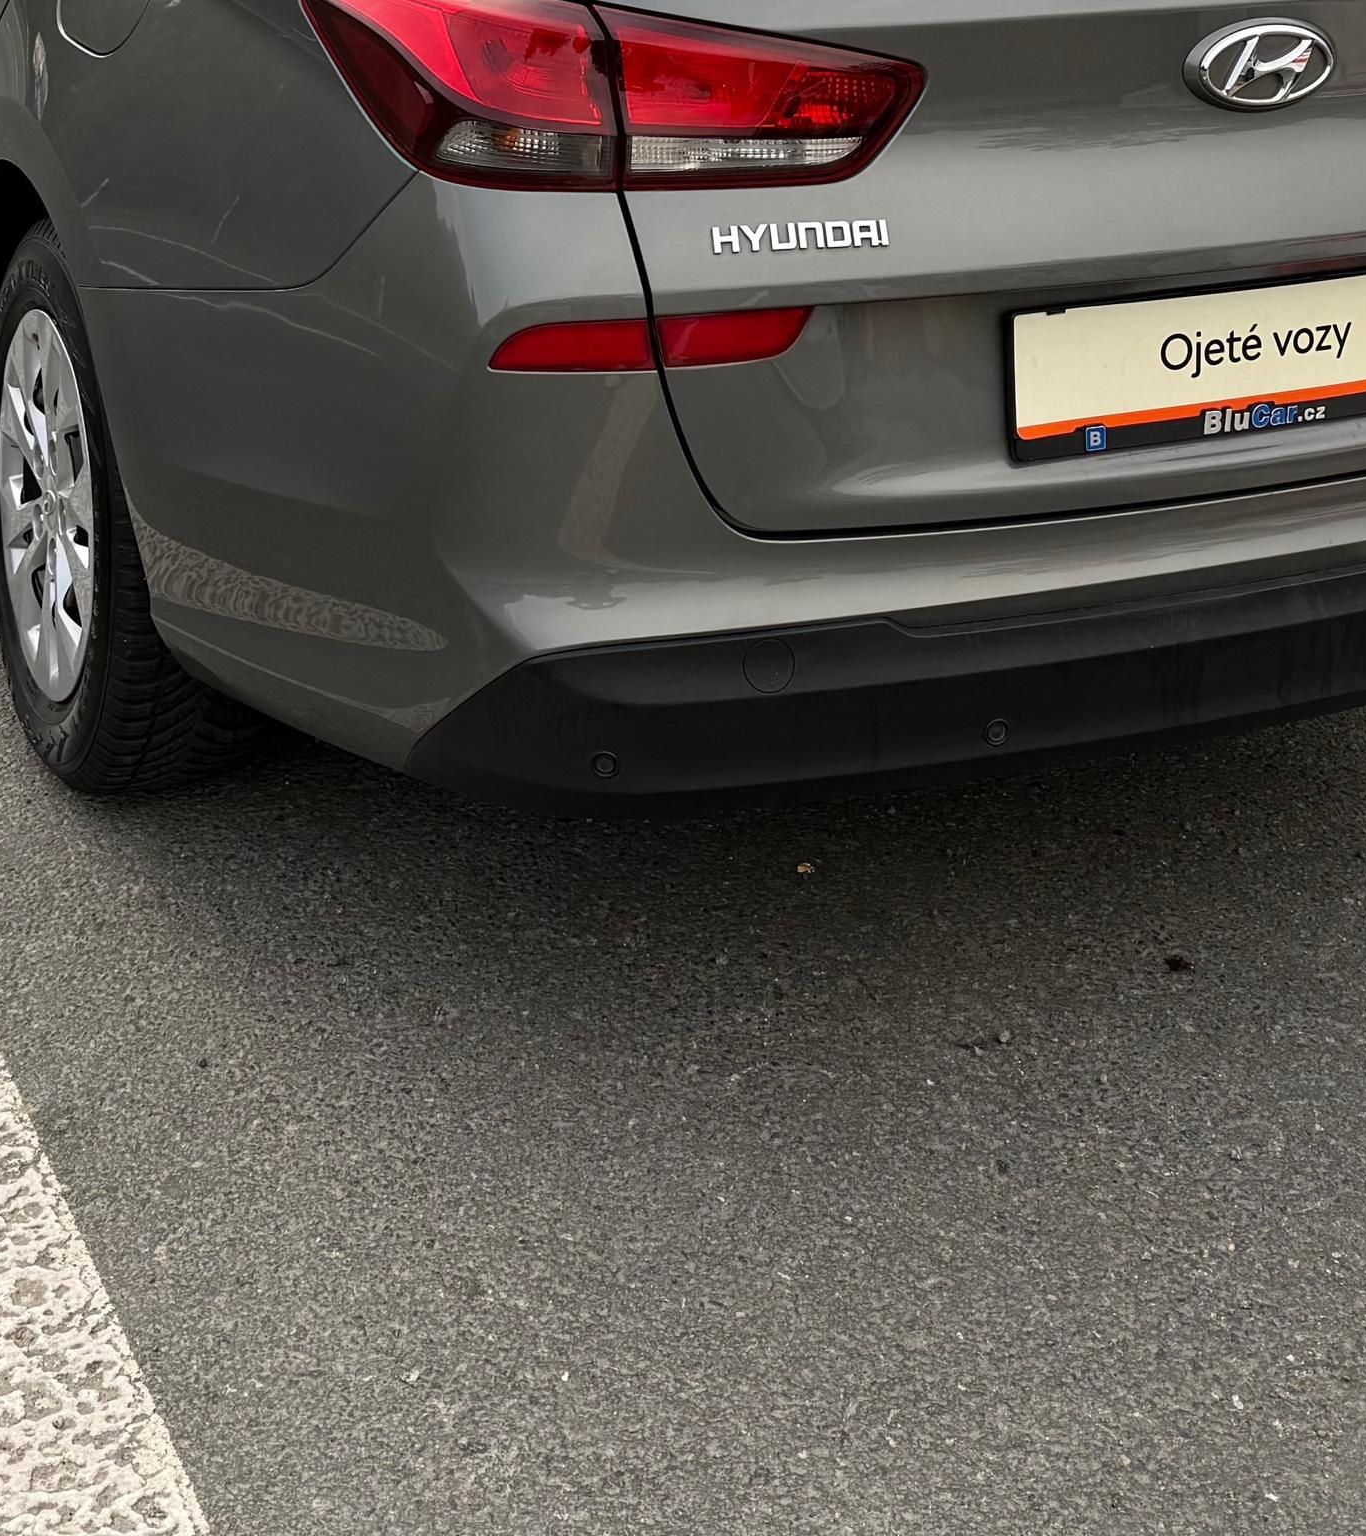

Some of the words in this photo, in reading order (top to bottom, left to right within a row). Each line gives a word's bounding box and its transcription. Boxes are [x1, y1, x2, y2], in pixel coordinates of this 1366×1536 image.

[711, 219, 890, 254] HYUNDAI
[1160, 324, 1263, 379] Ojeté
[1273, 321, 1352, 359] vozy
[1203, 403, 1326, 435] BluCar.cz
